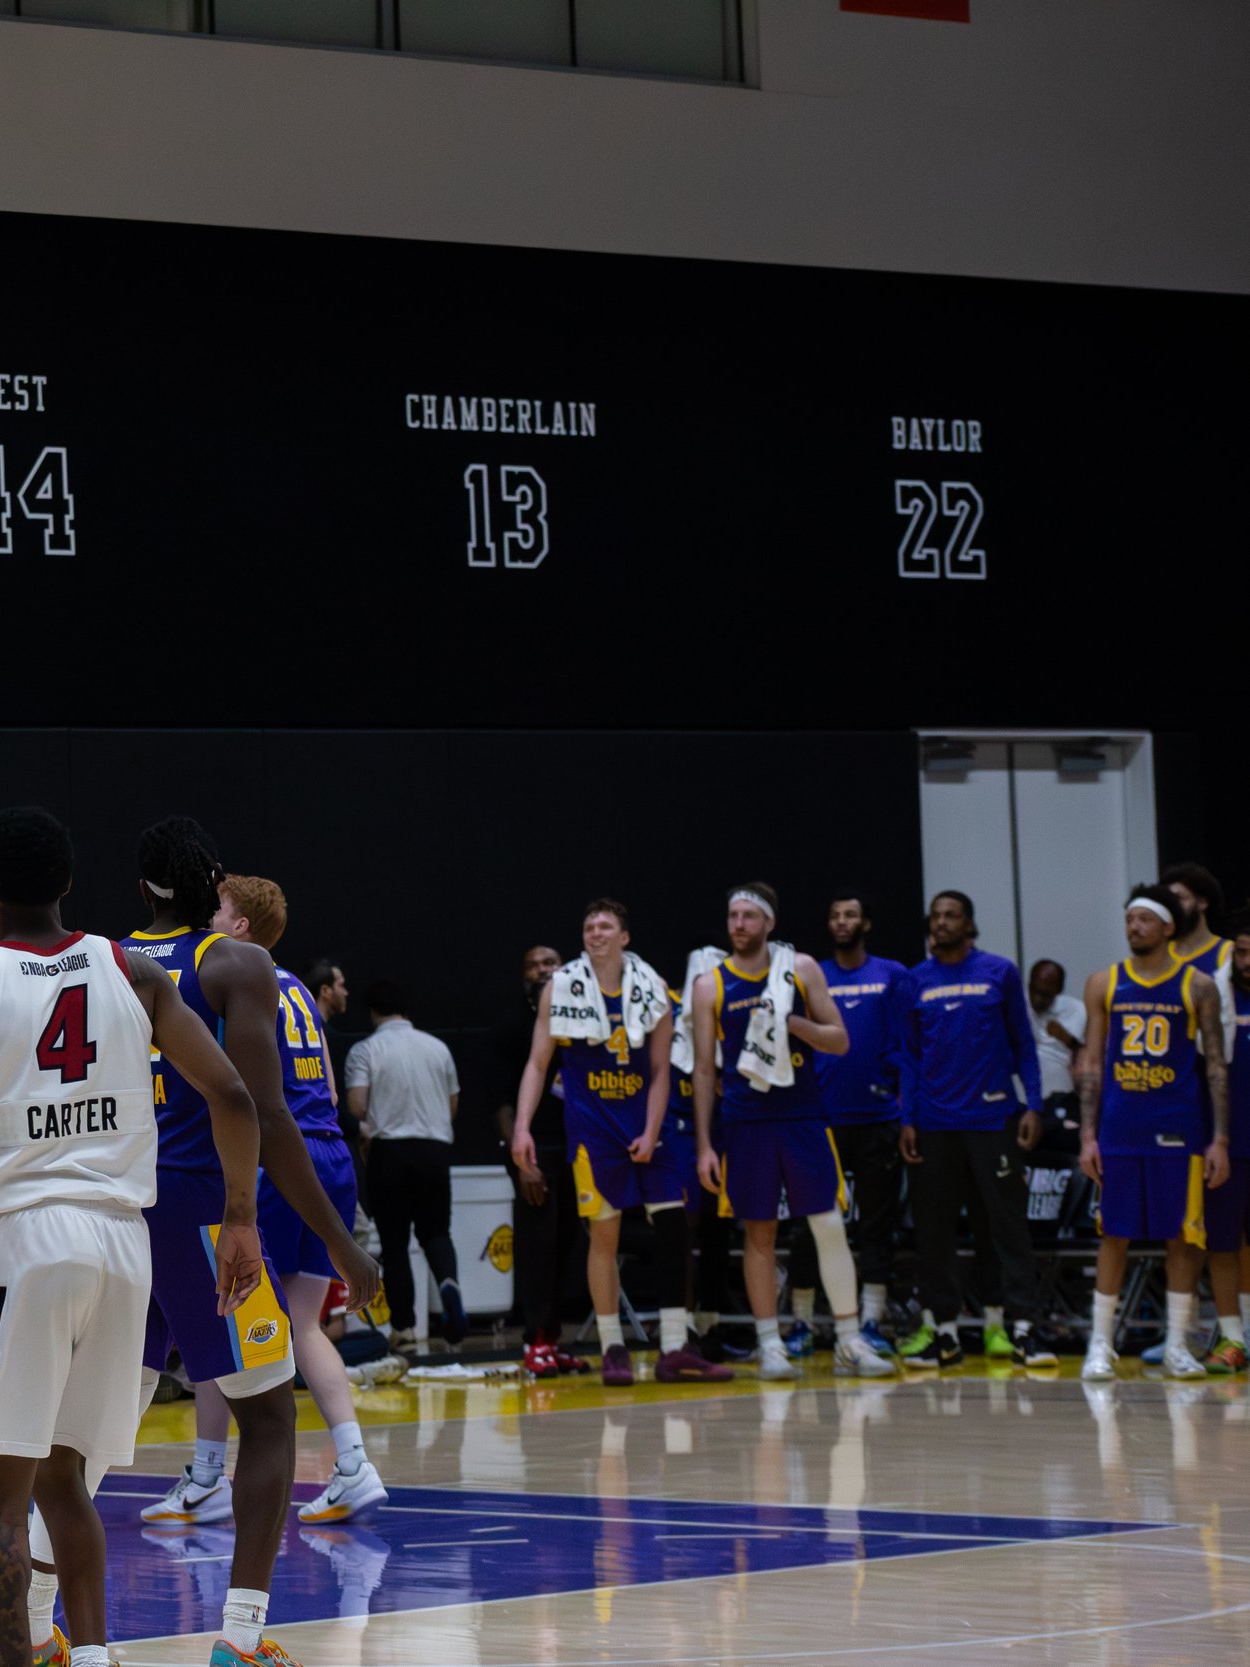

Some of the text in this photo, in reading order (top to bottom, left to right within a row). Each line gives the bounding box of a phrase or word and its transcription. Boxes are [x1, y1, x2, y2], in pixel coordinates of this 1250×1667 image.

[405, 393, 597, 437] CHAMBERLAIN
[891, 415, 983, 454] BAYLOR
[463, 463, 550, 569] 13
[894, 479, 988, 581] 22
[28, 961, 47, 977] NBA
[58, 953, 91, 972] LEAGUE
[150, 943, 176, 958] LEAGUE
[35, 982, 97, 1085] 4
[278, 986, 322, 1048] 21
[1121, 1014, 1171, 1057] 20
[605, 1026, 631, 1066] 4
[587, 1068, 645, 1097] bibigo
[26, 1097, 118, 1140] CARTER
